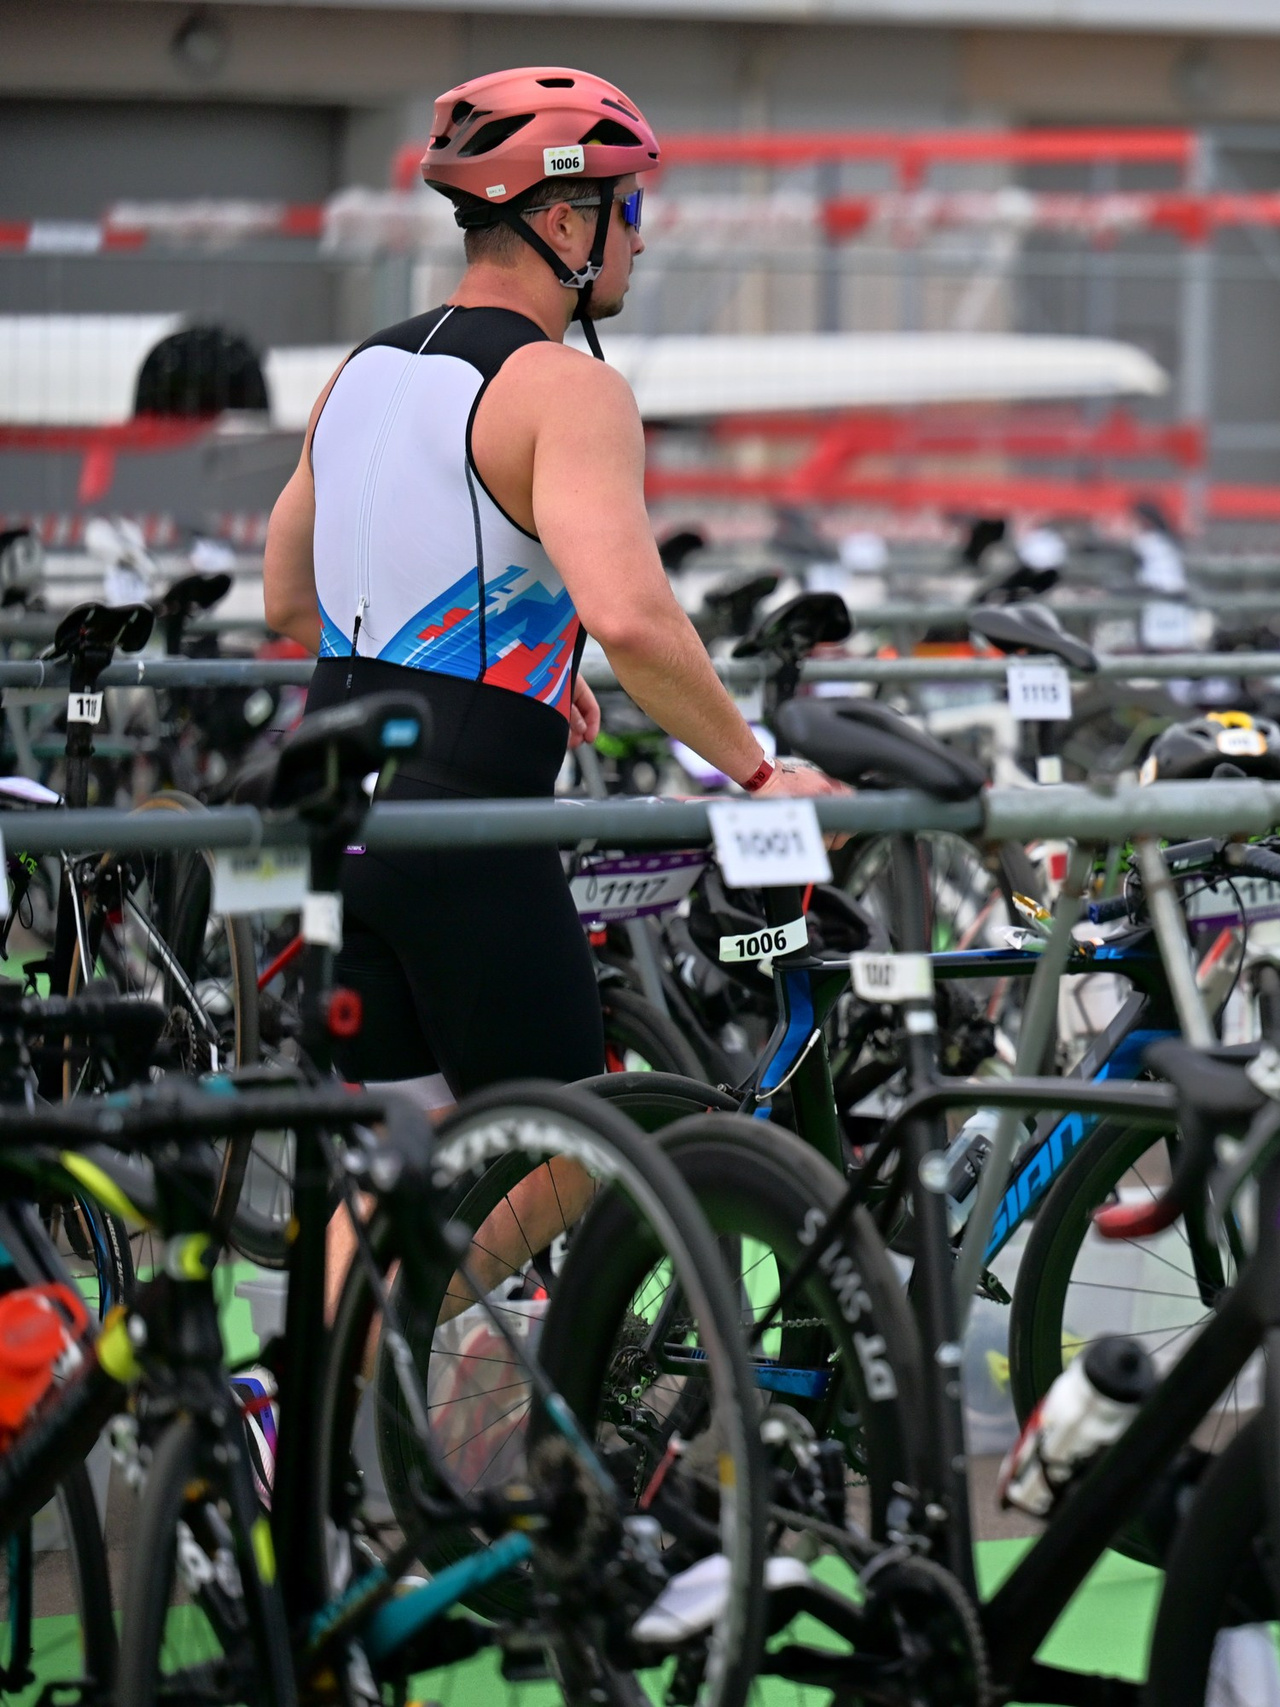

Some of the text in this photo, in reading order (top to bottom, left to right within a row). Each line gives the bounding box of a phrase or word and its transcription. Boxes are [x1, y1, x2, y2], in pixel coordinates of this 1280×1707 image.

[550, 157, 580, 171] 1006
[735, 830, 806, 858] 1001
[735, 929, 787, 958] 1006
[981, 1107, 1088, 1265] GIAN
